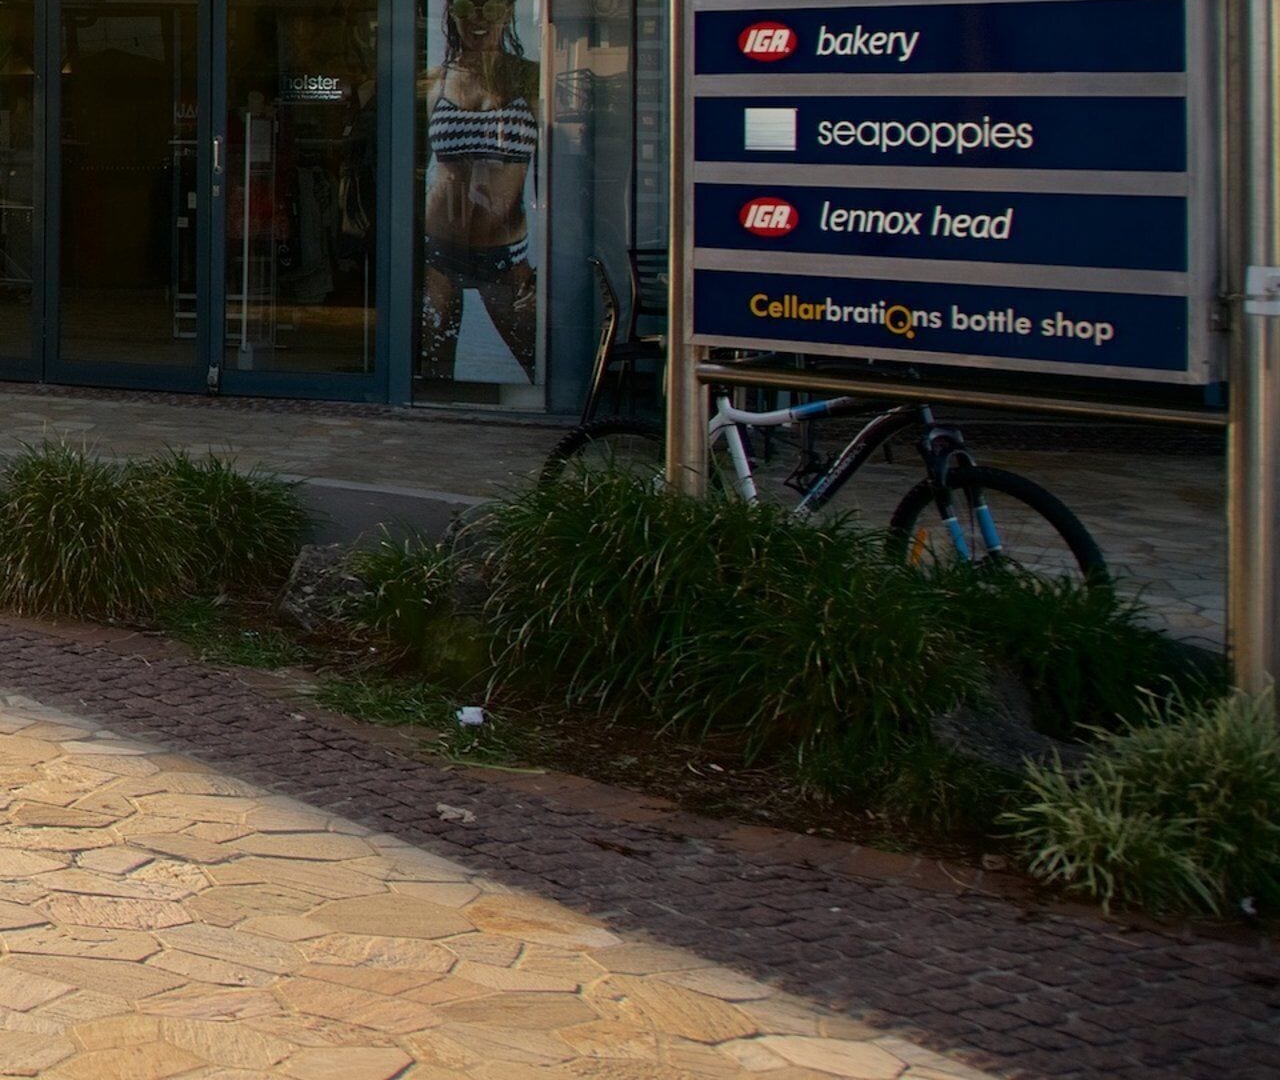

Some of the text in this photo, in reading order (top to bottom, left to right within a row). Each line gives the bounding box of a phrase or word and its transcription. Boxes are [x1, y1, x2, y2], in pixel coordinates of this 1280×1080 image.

[743, 25, 920, 63] IGA bakery
[817, 116, 1034, 155] seapoppies
[743, 201, 1015, 239] IGA lennox head
[951, 306, 1032, 336] bottle
[1042, 316, 1115, 346] shop
